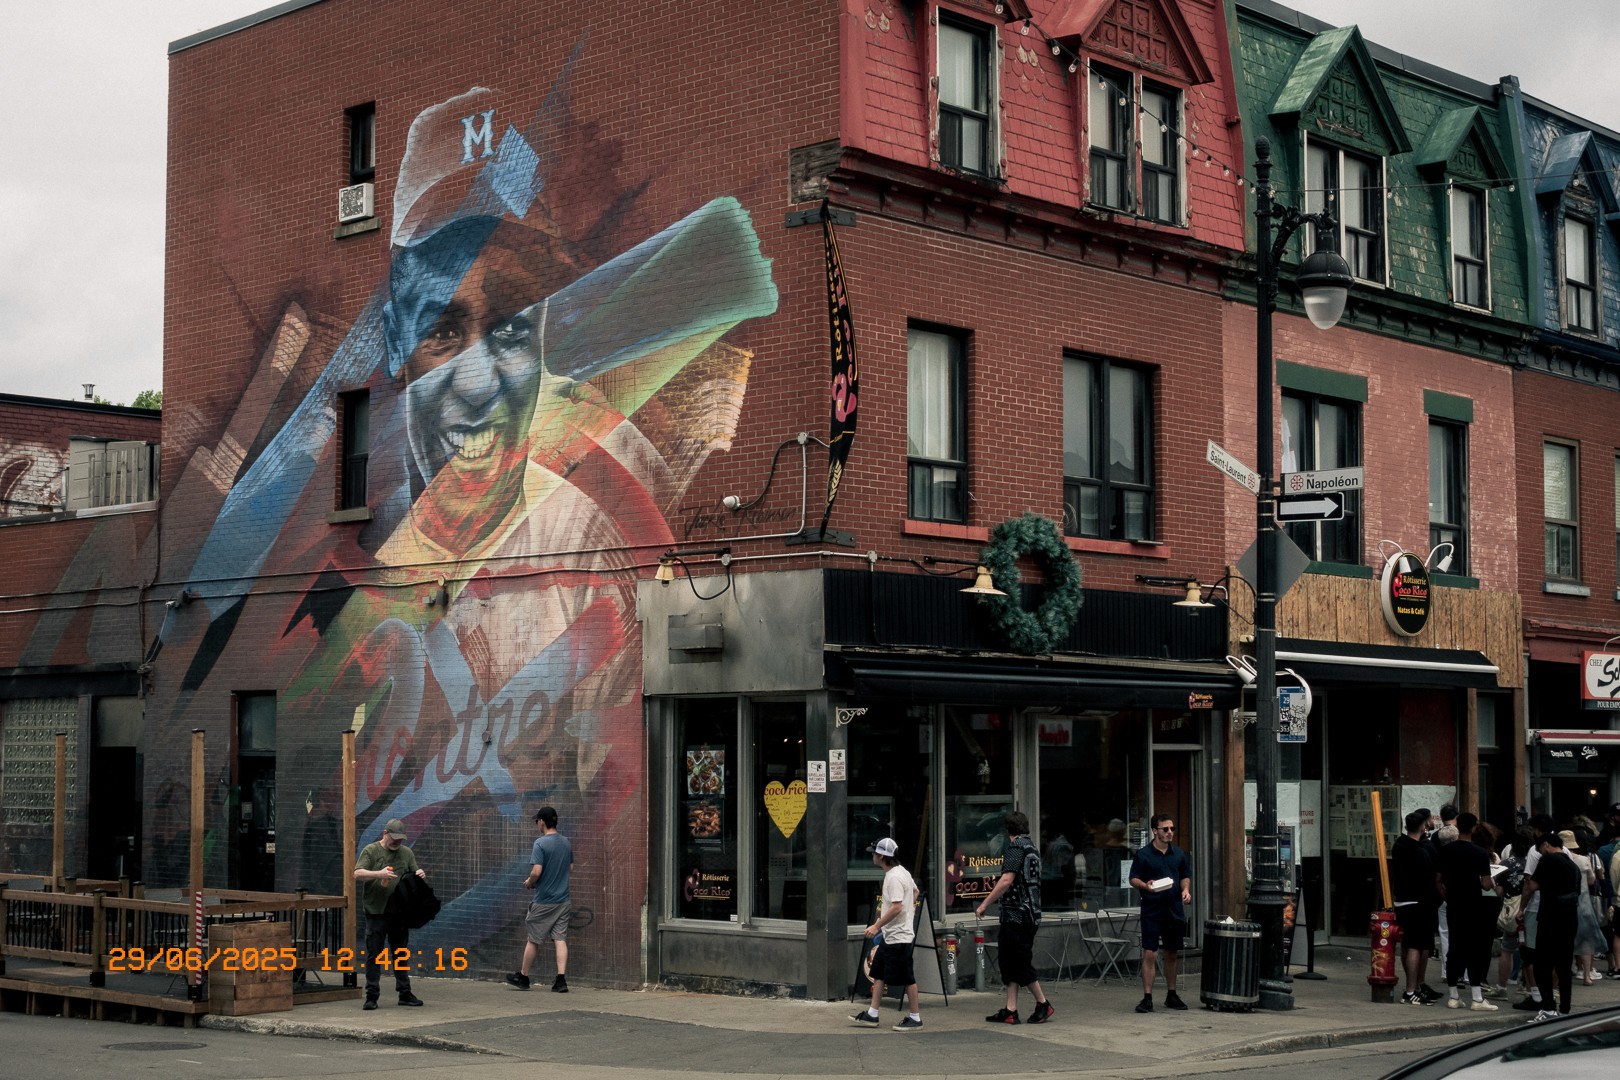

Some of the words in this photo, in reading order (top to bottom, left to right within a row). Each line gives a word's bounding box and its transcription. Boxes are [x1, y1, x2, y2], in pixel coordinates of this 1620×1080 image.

[460, 108, 497, 164] M
[1210, 451, 1247, 481] Saint-Laurent
[1306, 475, 1359, 490] Napoléon
[1412, 585, 1428, 596] Rico
[1397, 606, 1411, 614] Natas
[1411, 607, 1415, 615] &
[1414, 607, 1425, 615] Café
[1589, 658, 1603, 667] CHEZ
[1597, 700, 1610, 708] POUR
[969, 855, 1005, 868] Rôtisseri
